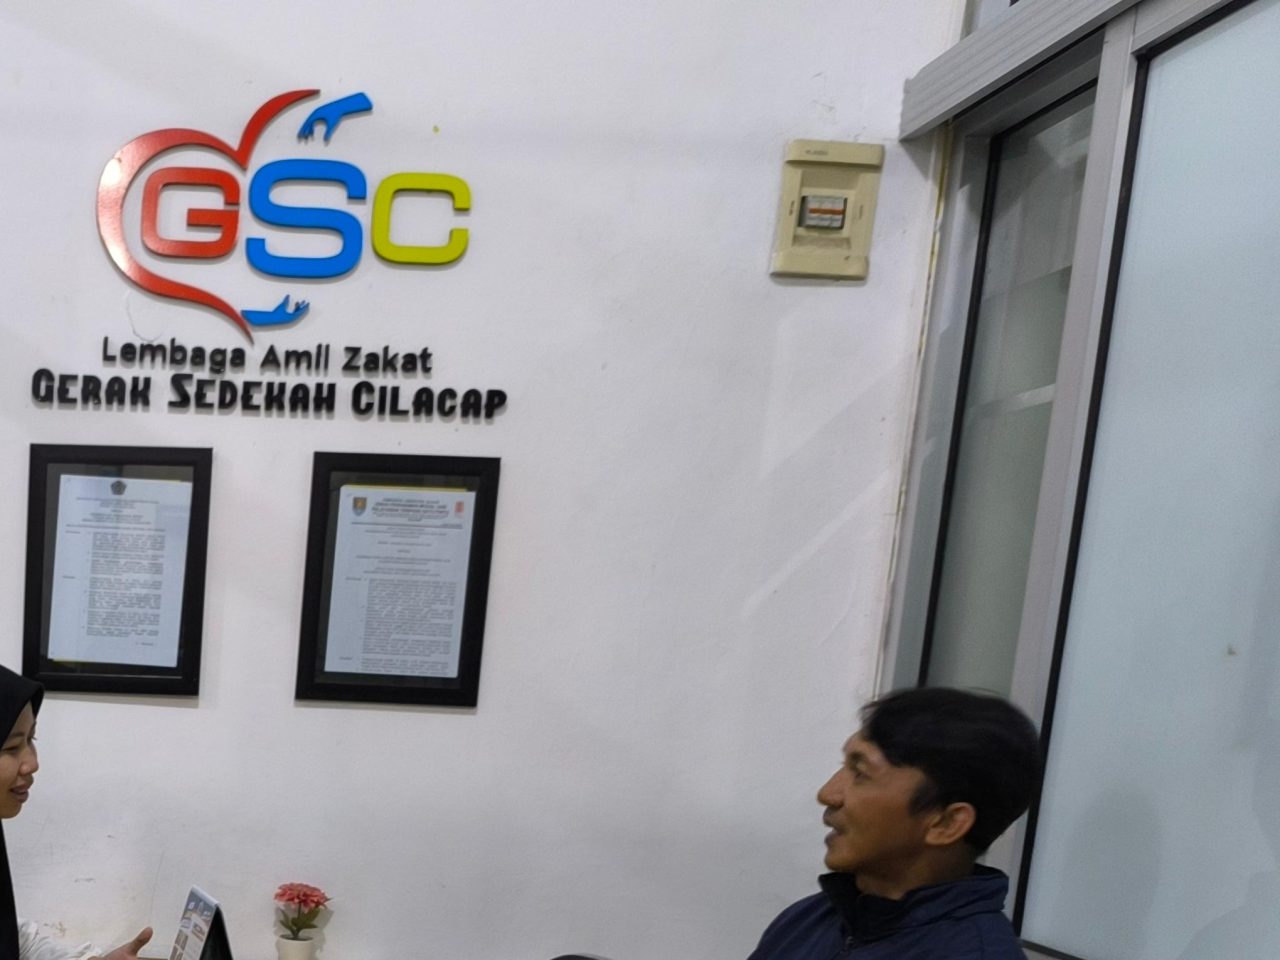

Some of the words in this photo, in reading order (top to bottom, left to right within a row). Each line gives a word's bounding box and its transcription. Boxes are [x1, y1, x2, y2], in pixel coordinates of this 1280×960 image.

[141, 158, 472, 279] GSC
[102, 336, 246, 375] Lembaga
[260, 343, 330, 373] Amil
[342, 345, 433, 374] Zakat
[31, 368, 151, 410] GERAK
[167, 373, 336, 413] SEDEKAH
[351, 381, 508, 420] CILACAP
